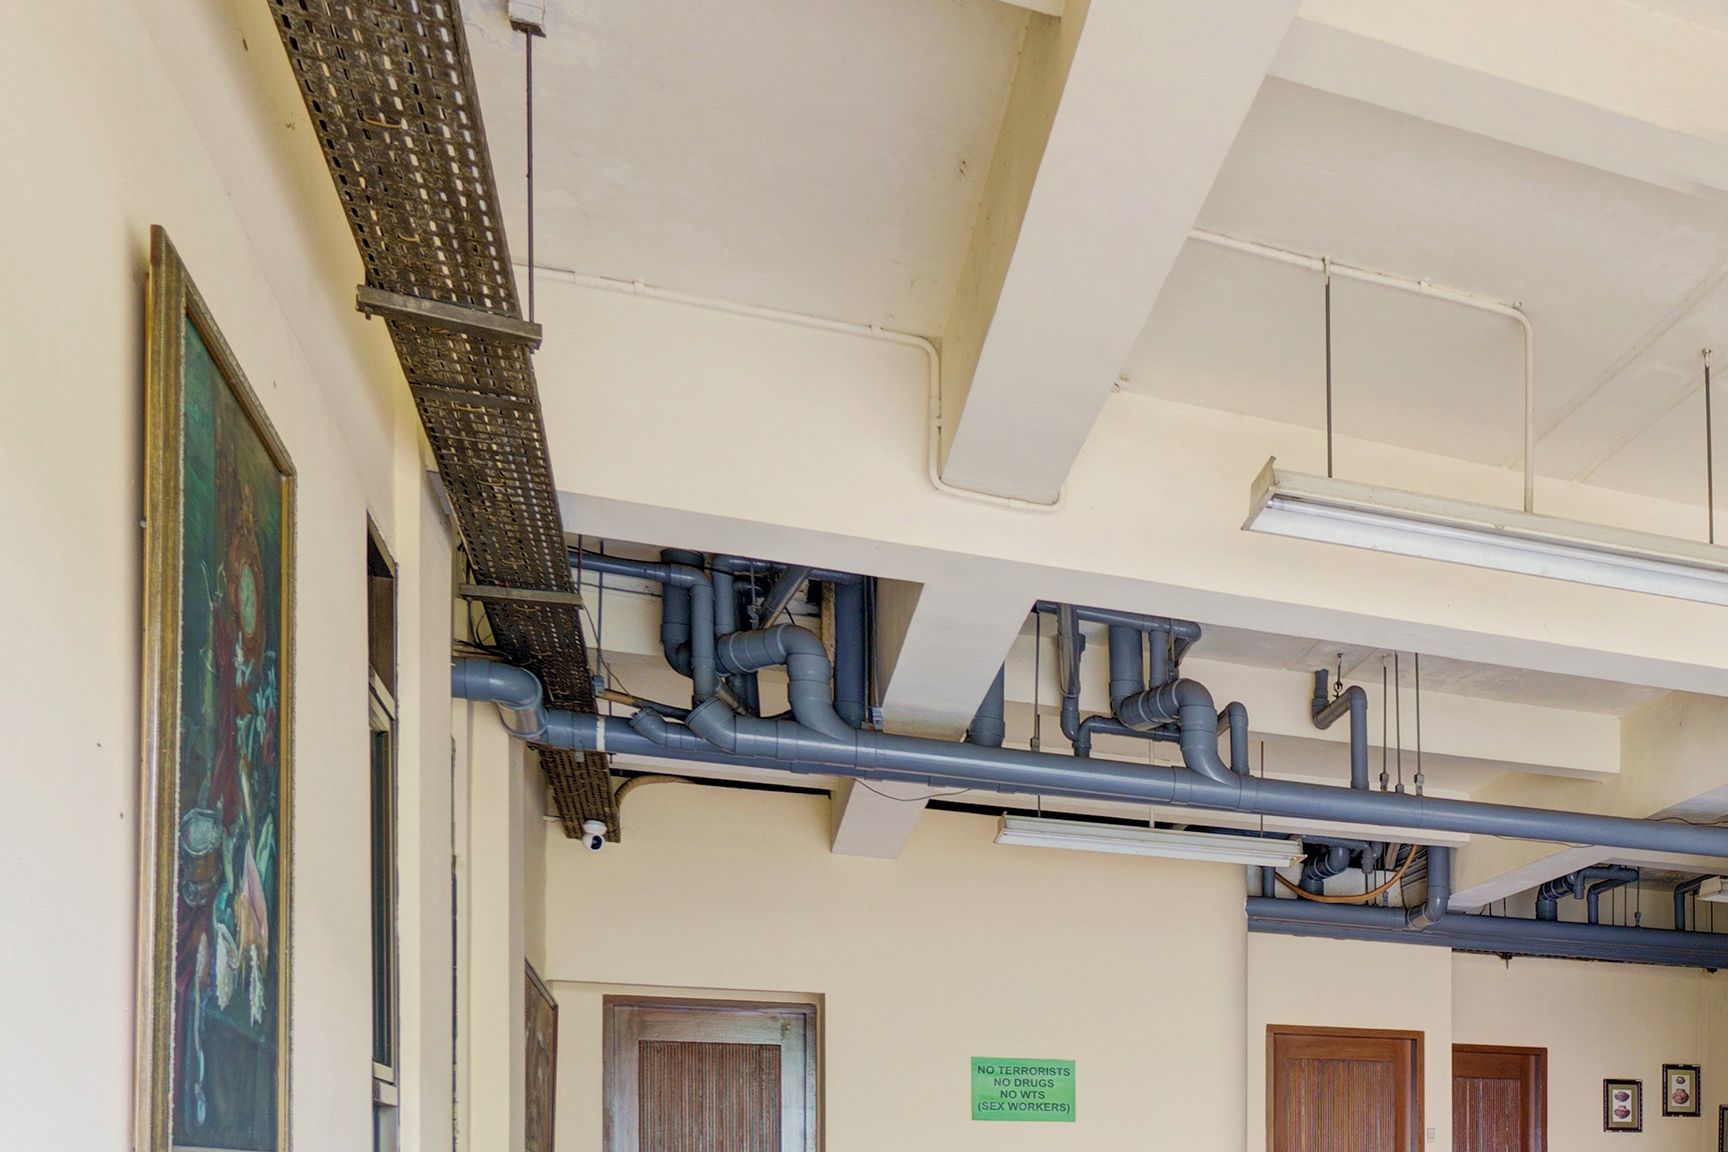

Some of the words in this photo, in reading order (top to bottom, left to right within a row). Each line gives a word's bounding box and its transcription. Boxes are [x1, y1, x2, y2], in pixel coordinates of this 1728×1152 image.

[977, 1065, 995, 1075] NO
[998, 1066, 1071, 1077] TERRORISTS
[993, 1078, 1011, 1087] NO
[1014, 1079, 1055, 1088] DRUGS
[1000, 1090, 1017, 1099] NO
[1020, 1090, 1046, 1100] WTS
[977, 1101, 1005, 1112] (SEX
[1007, 1102, 1071, 1114] WORKERS)
